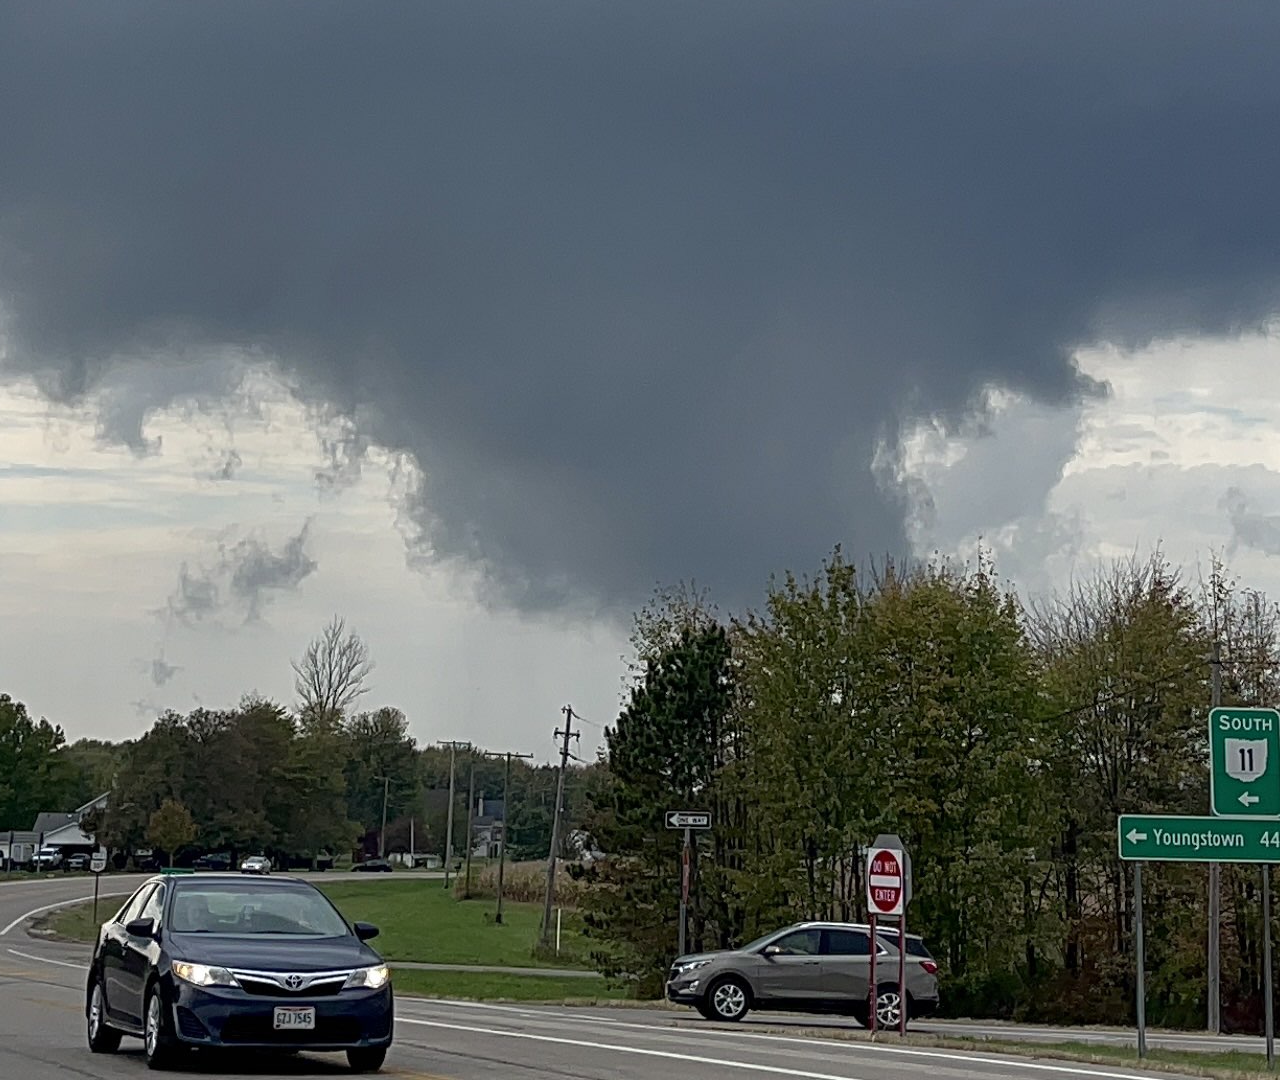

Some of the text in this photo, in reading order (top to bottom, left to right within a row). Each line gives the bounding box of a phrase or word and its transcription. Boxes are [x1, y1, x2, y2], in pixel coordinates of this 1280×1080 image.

[1219, 715, 1272, 731] SOUTH
[1239, 748, 1254, 771] 11
[1153, 828, 1280, 850] Youngstown 44
[873, 860, 897, 874] DO NOT
[875, 889, 896, 902] ENTER
